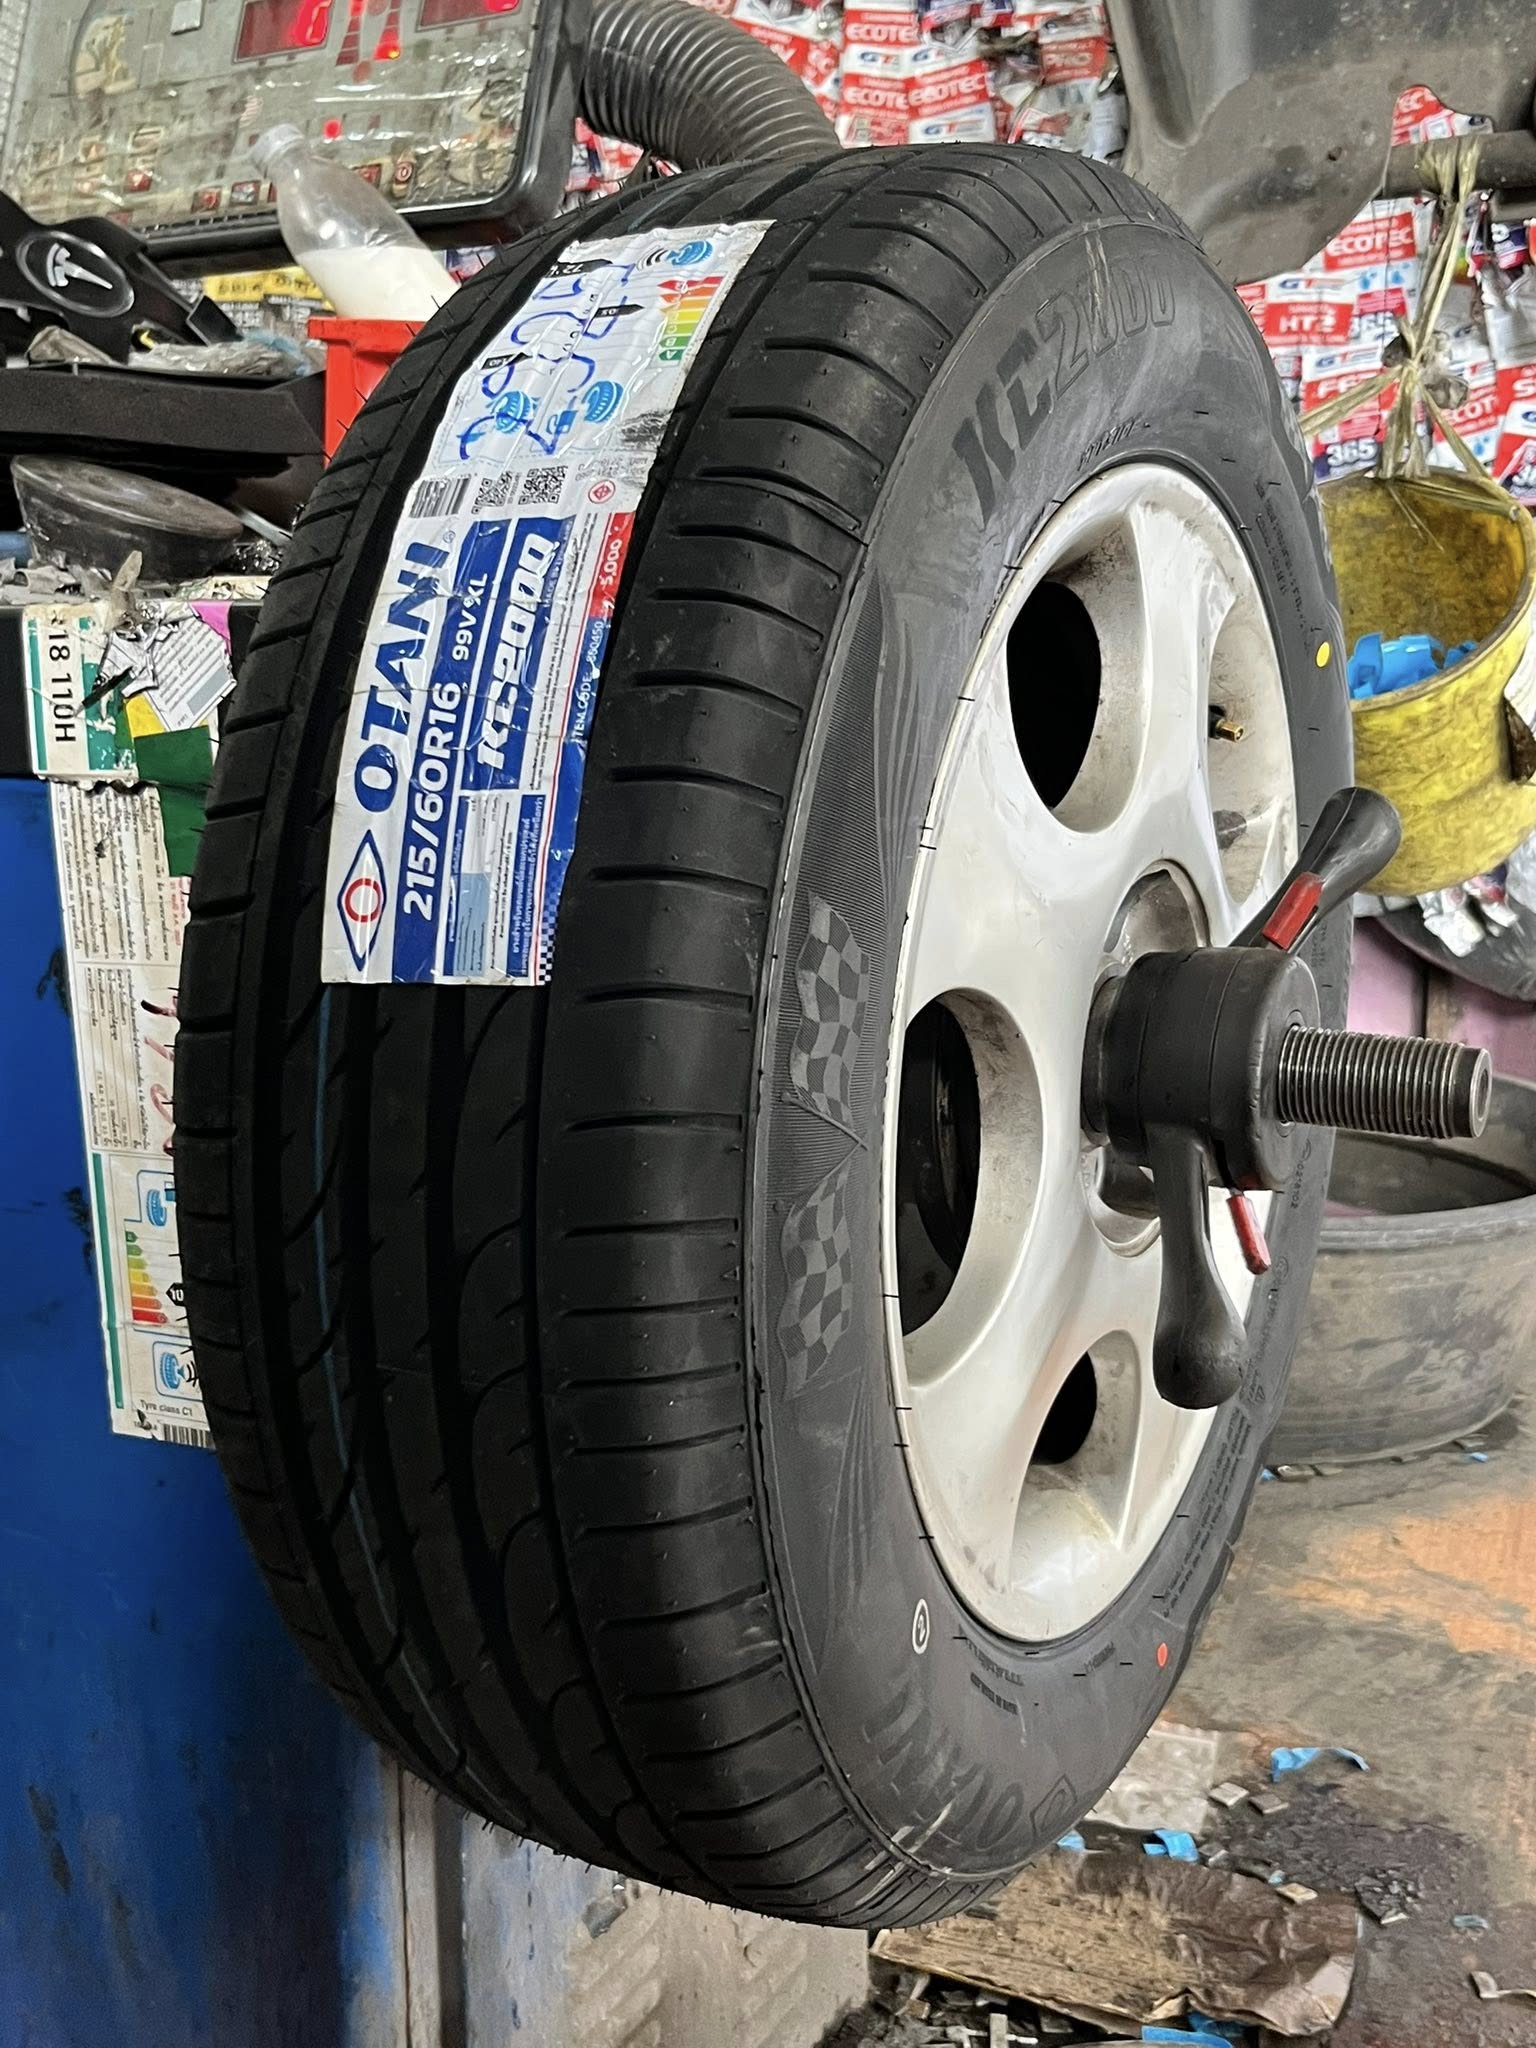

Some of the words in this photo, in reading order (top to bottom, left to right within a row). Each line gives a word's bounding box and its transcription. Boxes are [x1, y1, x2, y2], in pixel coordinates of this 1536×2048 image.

[51, 672, 76, 742] 110H
[354, 541, 450, 813] OTANI
[404, 682, 462, 922] 215/60R16
[452, 609, 477, 661] 99V
[478, 532, 560, 770] KC2000
